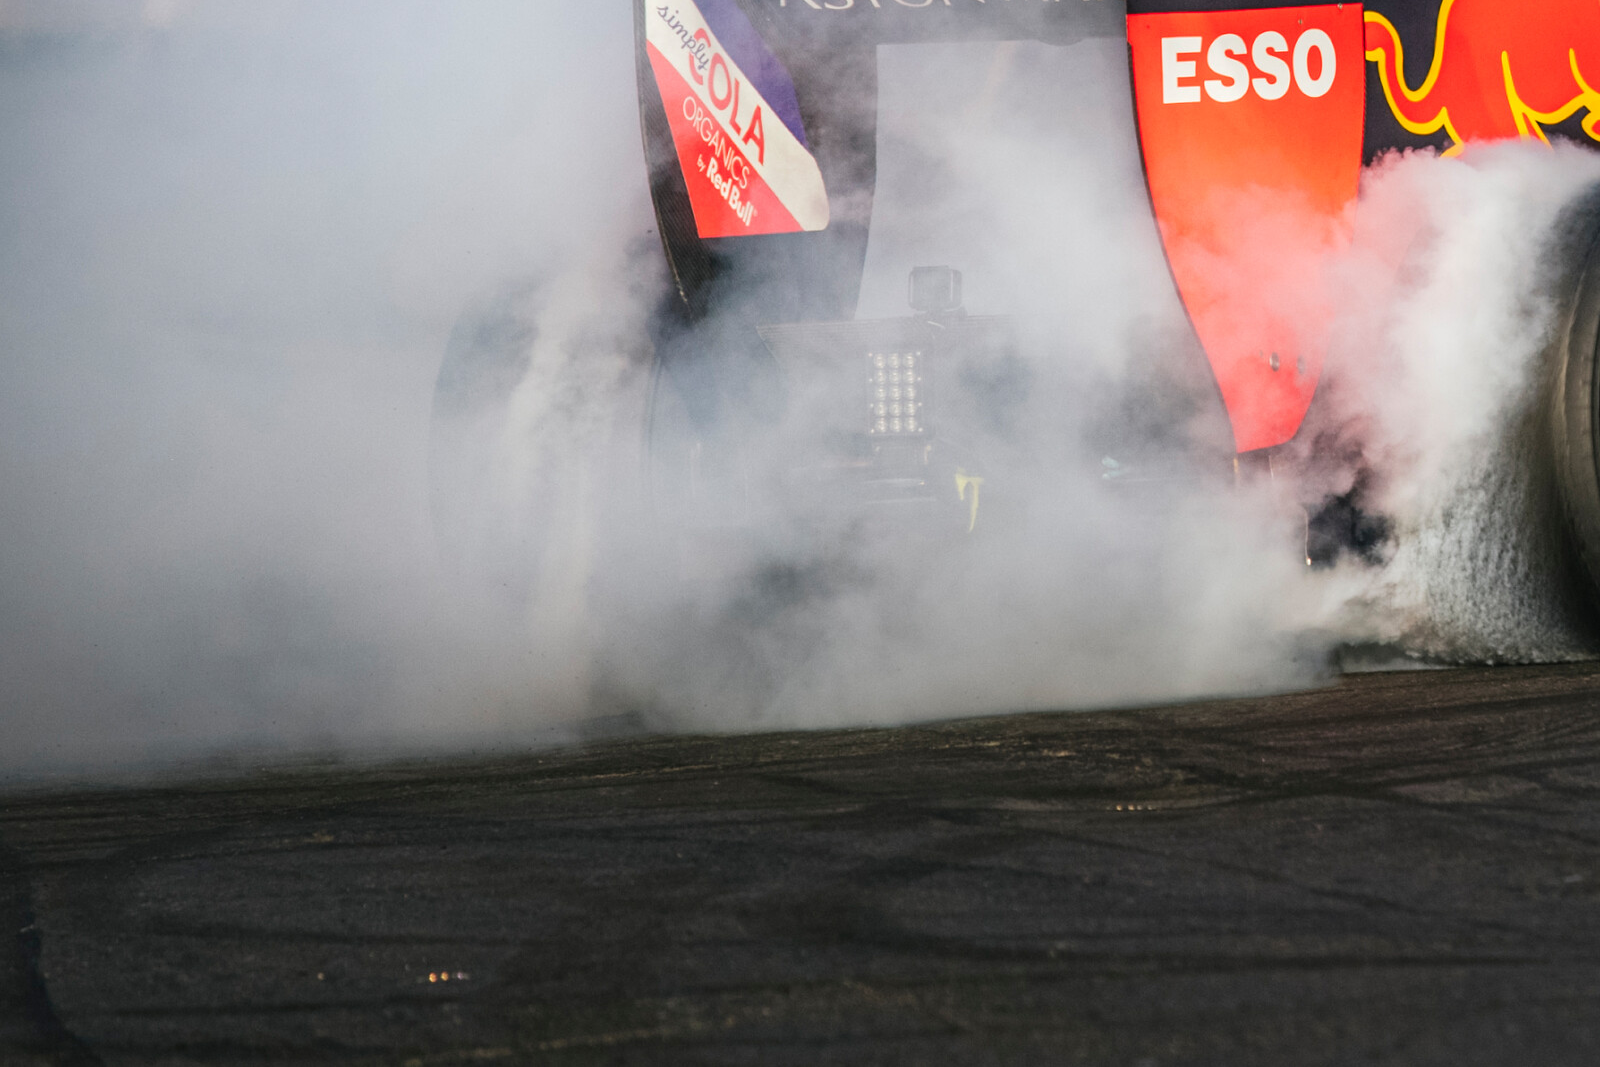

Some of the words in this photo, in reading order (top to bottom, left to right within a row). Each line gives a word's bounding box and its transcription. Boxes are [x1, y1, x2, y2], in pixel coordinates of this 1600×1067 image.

[656, 5, 710, 71] simply
[1161, 28, 1337, 104] ESSO
[688, 27, 765, 166] COLA
[683, 96, 750, 190] ORGANICS
